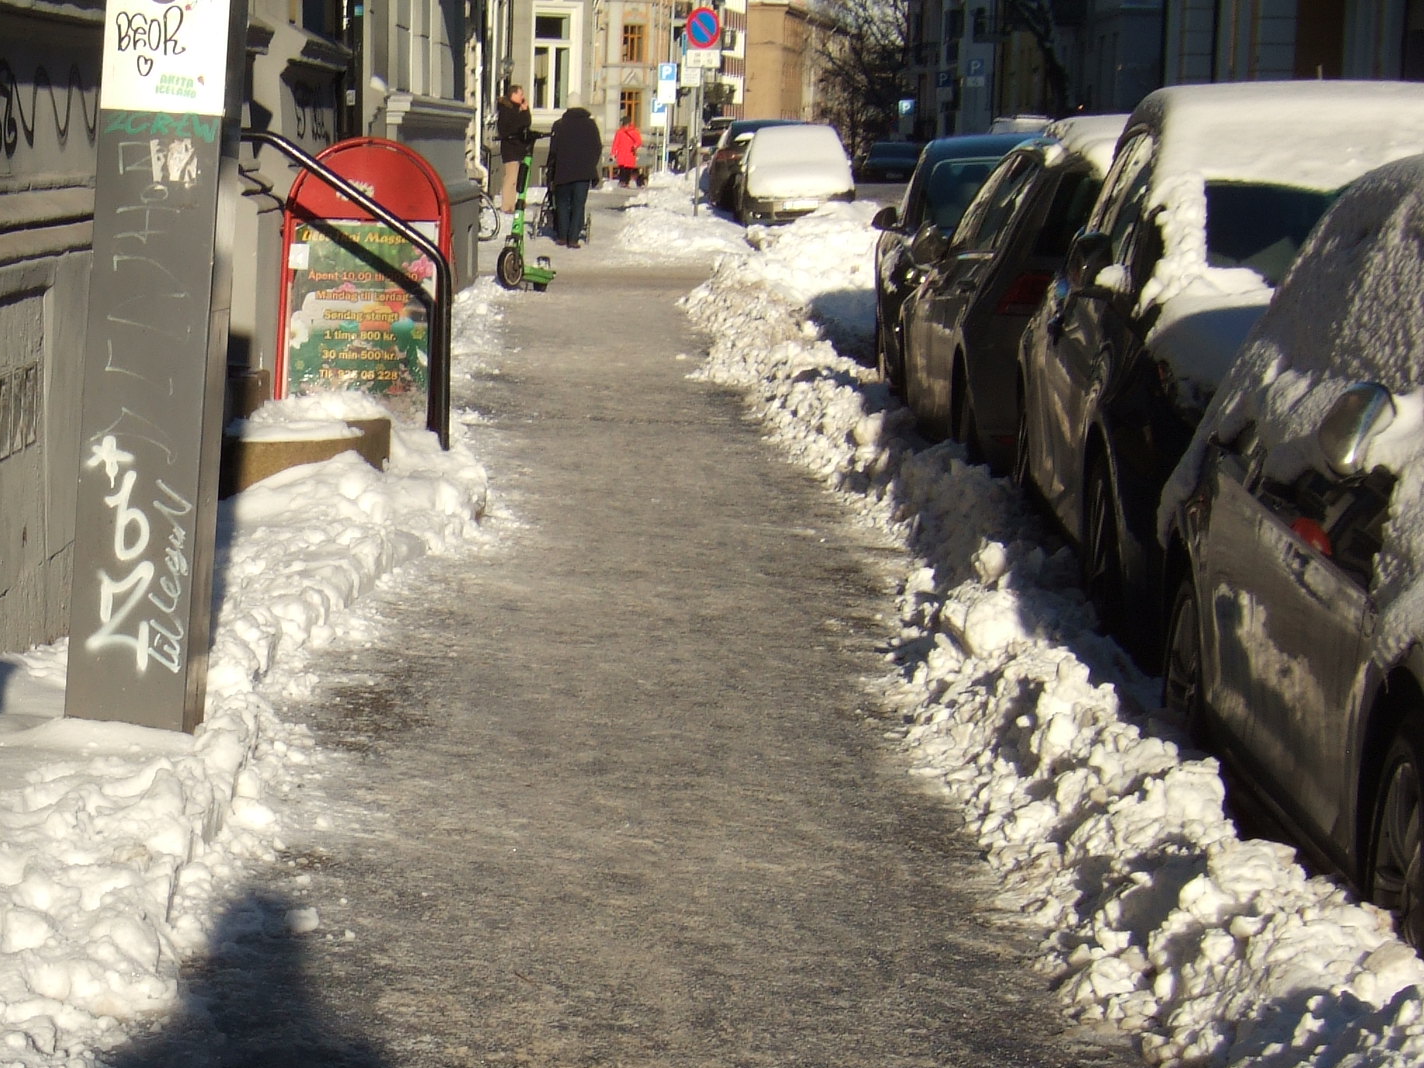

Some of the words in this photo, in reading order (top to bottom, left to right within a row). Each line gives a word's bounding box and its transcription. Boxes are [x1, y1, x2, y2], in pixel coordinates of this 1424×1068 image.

[662, 65, 672, 79] P
[159, 74, 194, 88] AKITA
[155, 86, 197, 99] ICELAND
[902, 102, 911, 114] P
[316, 291, 358, 303] Mandag
[359, 291, 372, 301] til
[324, 309, 364, 322] Søndag
[365, 310, 400, 322] stengt
[324, 330, 331, 339] 1
[339, 350, 358, 360] min
